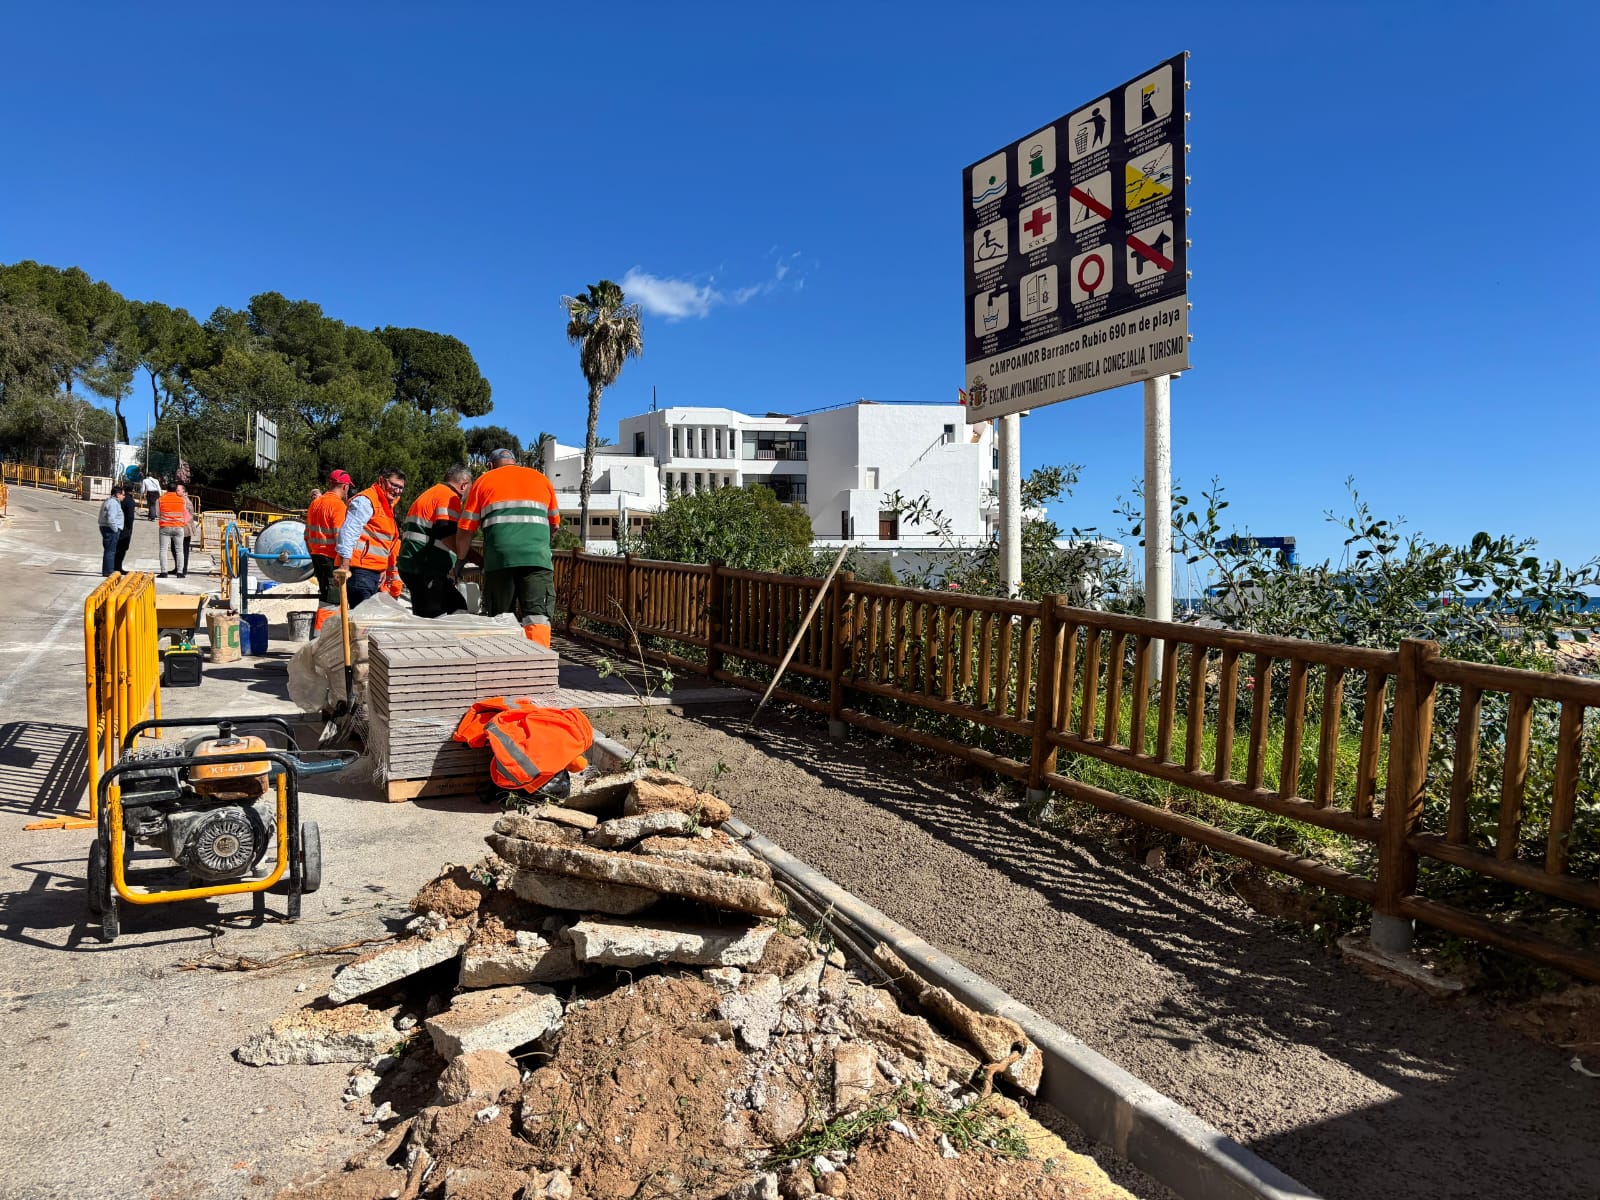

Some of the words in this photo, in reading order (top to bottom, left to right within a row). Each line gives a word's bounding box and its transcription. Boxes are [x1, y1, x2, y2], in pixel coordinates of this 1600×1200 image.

[990, 350, 1040, 376] CAMPOAMOR
[1042, 340, 1080, 360] Barranco
[1082, 328, 1107, 349] Rubio
[1110, 322, 1126, 339] 690
[1129, 322, 1136, 334] m
[1139, 314, 1150, 331] de
[1152, 308, 1180, 330] playa
[1011, 374, 1055, 400] AYUNTAMIENTO
[1058, 370, 1066, 386] DE
[1069, 360, 1100, 382] ORIHUELA
[1149, 336, 1183, 361] TURISMO
